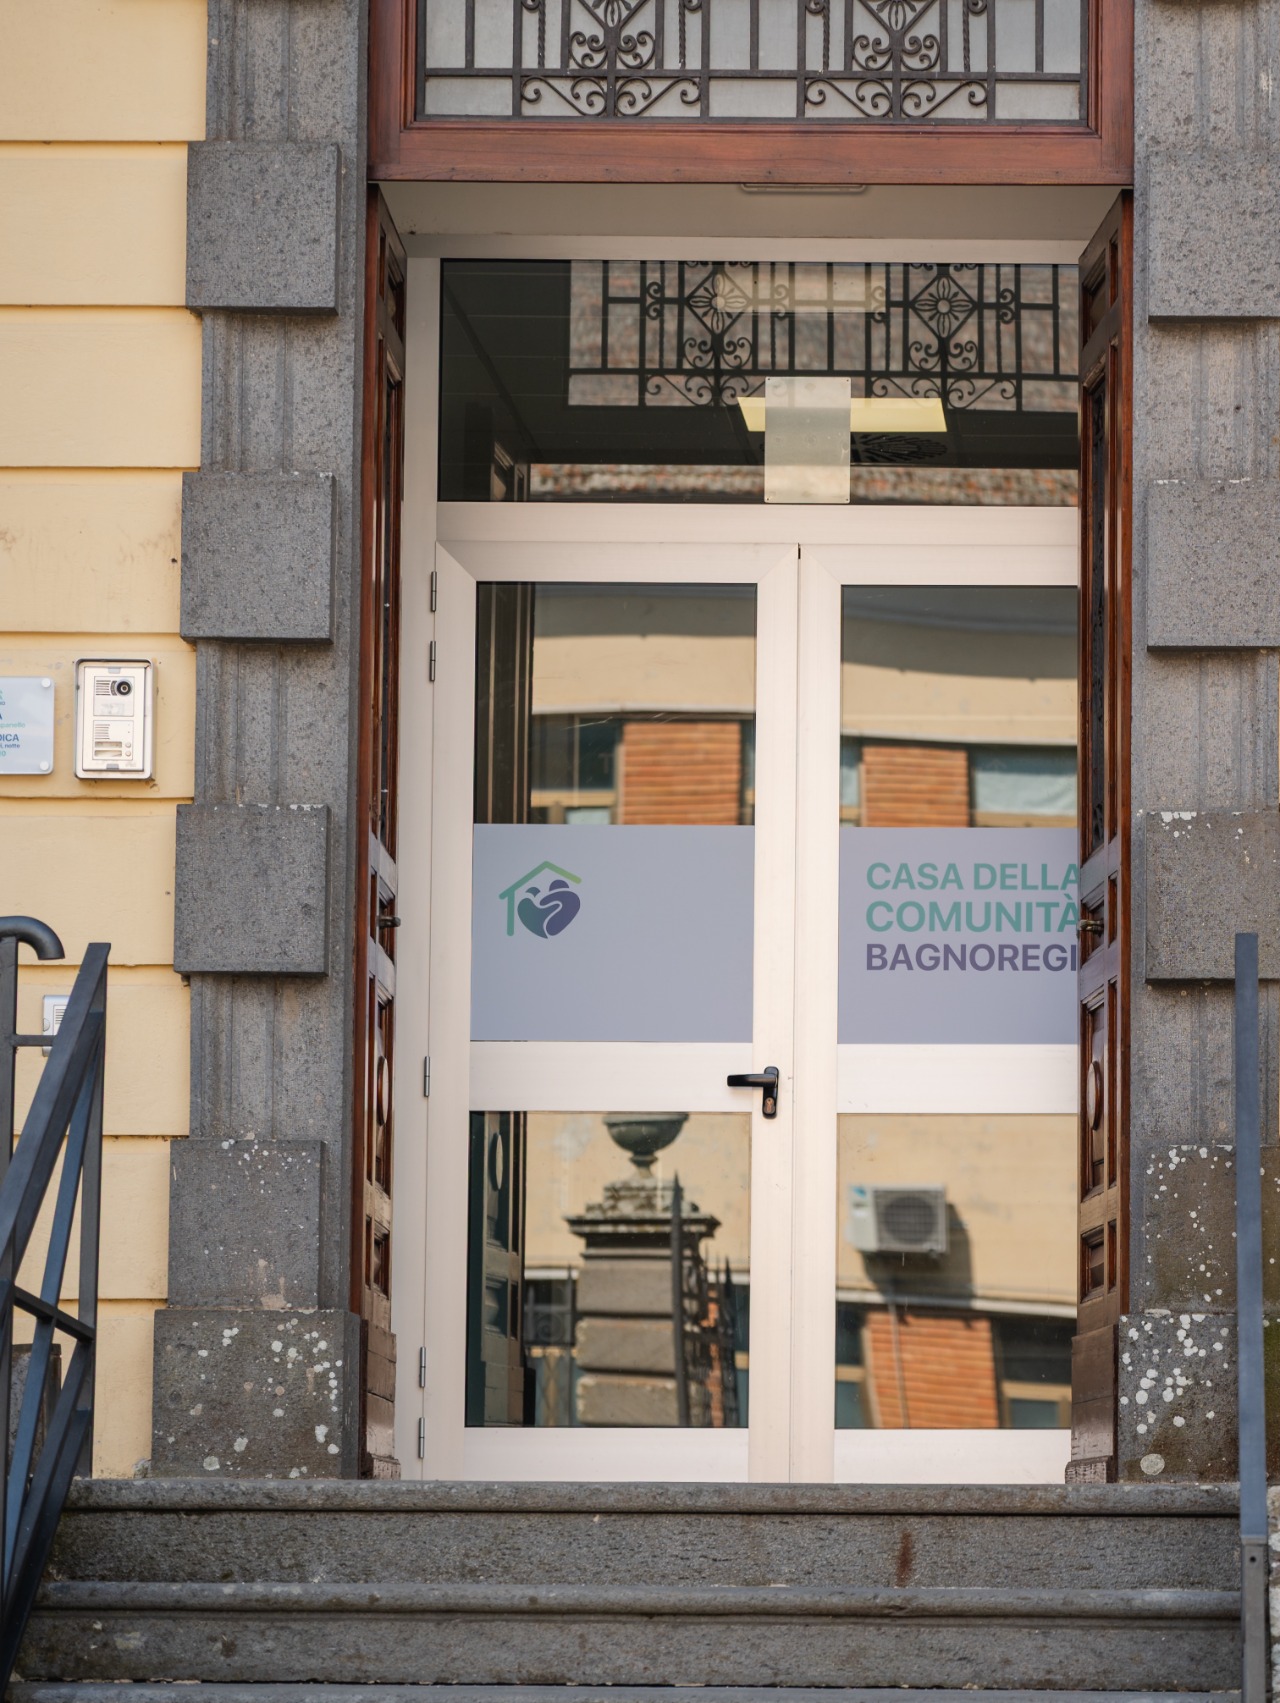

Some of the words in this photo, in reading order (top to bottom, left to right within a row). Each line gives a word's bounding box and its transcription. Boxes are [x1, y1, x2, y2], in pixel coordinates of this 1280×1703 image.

[866, 862, 964, 891] CASA
[974, 862, 1078, 891] DELLA
[866, 893, 1078, 933] COMUNITÀ
[866, 943, 1077, 972] BAGNOREGI
